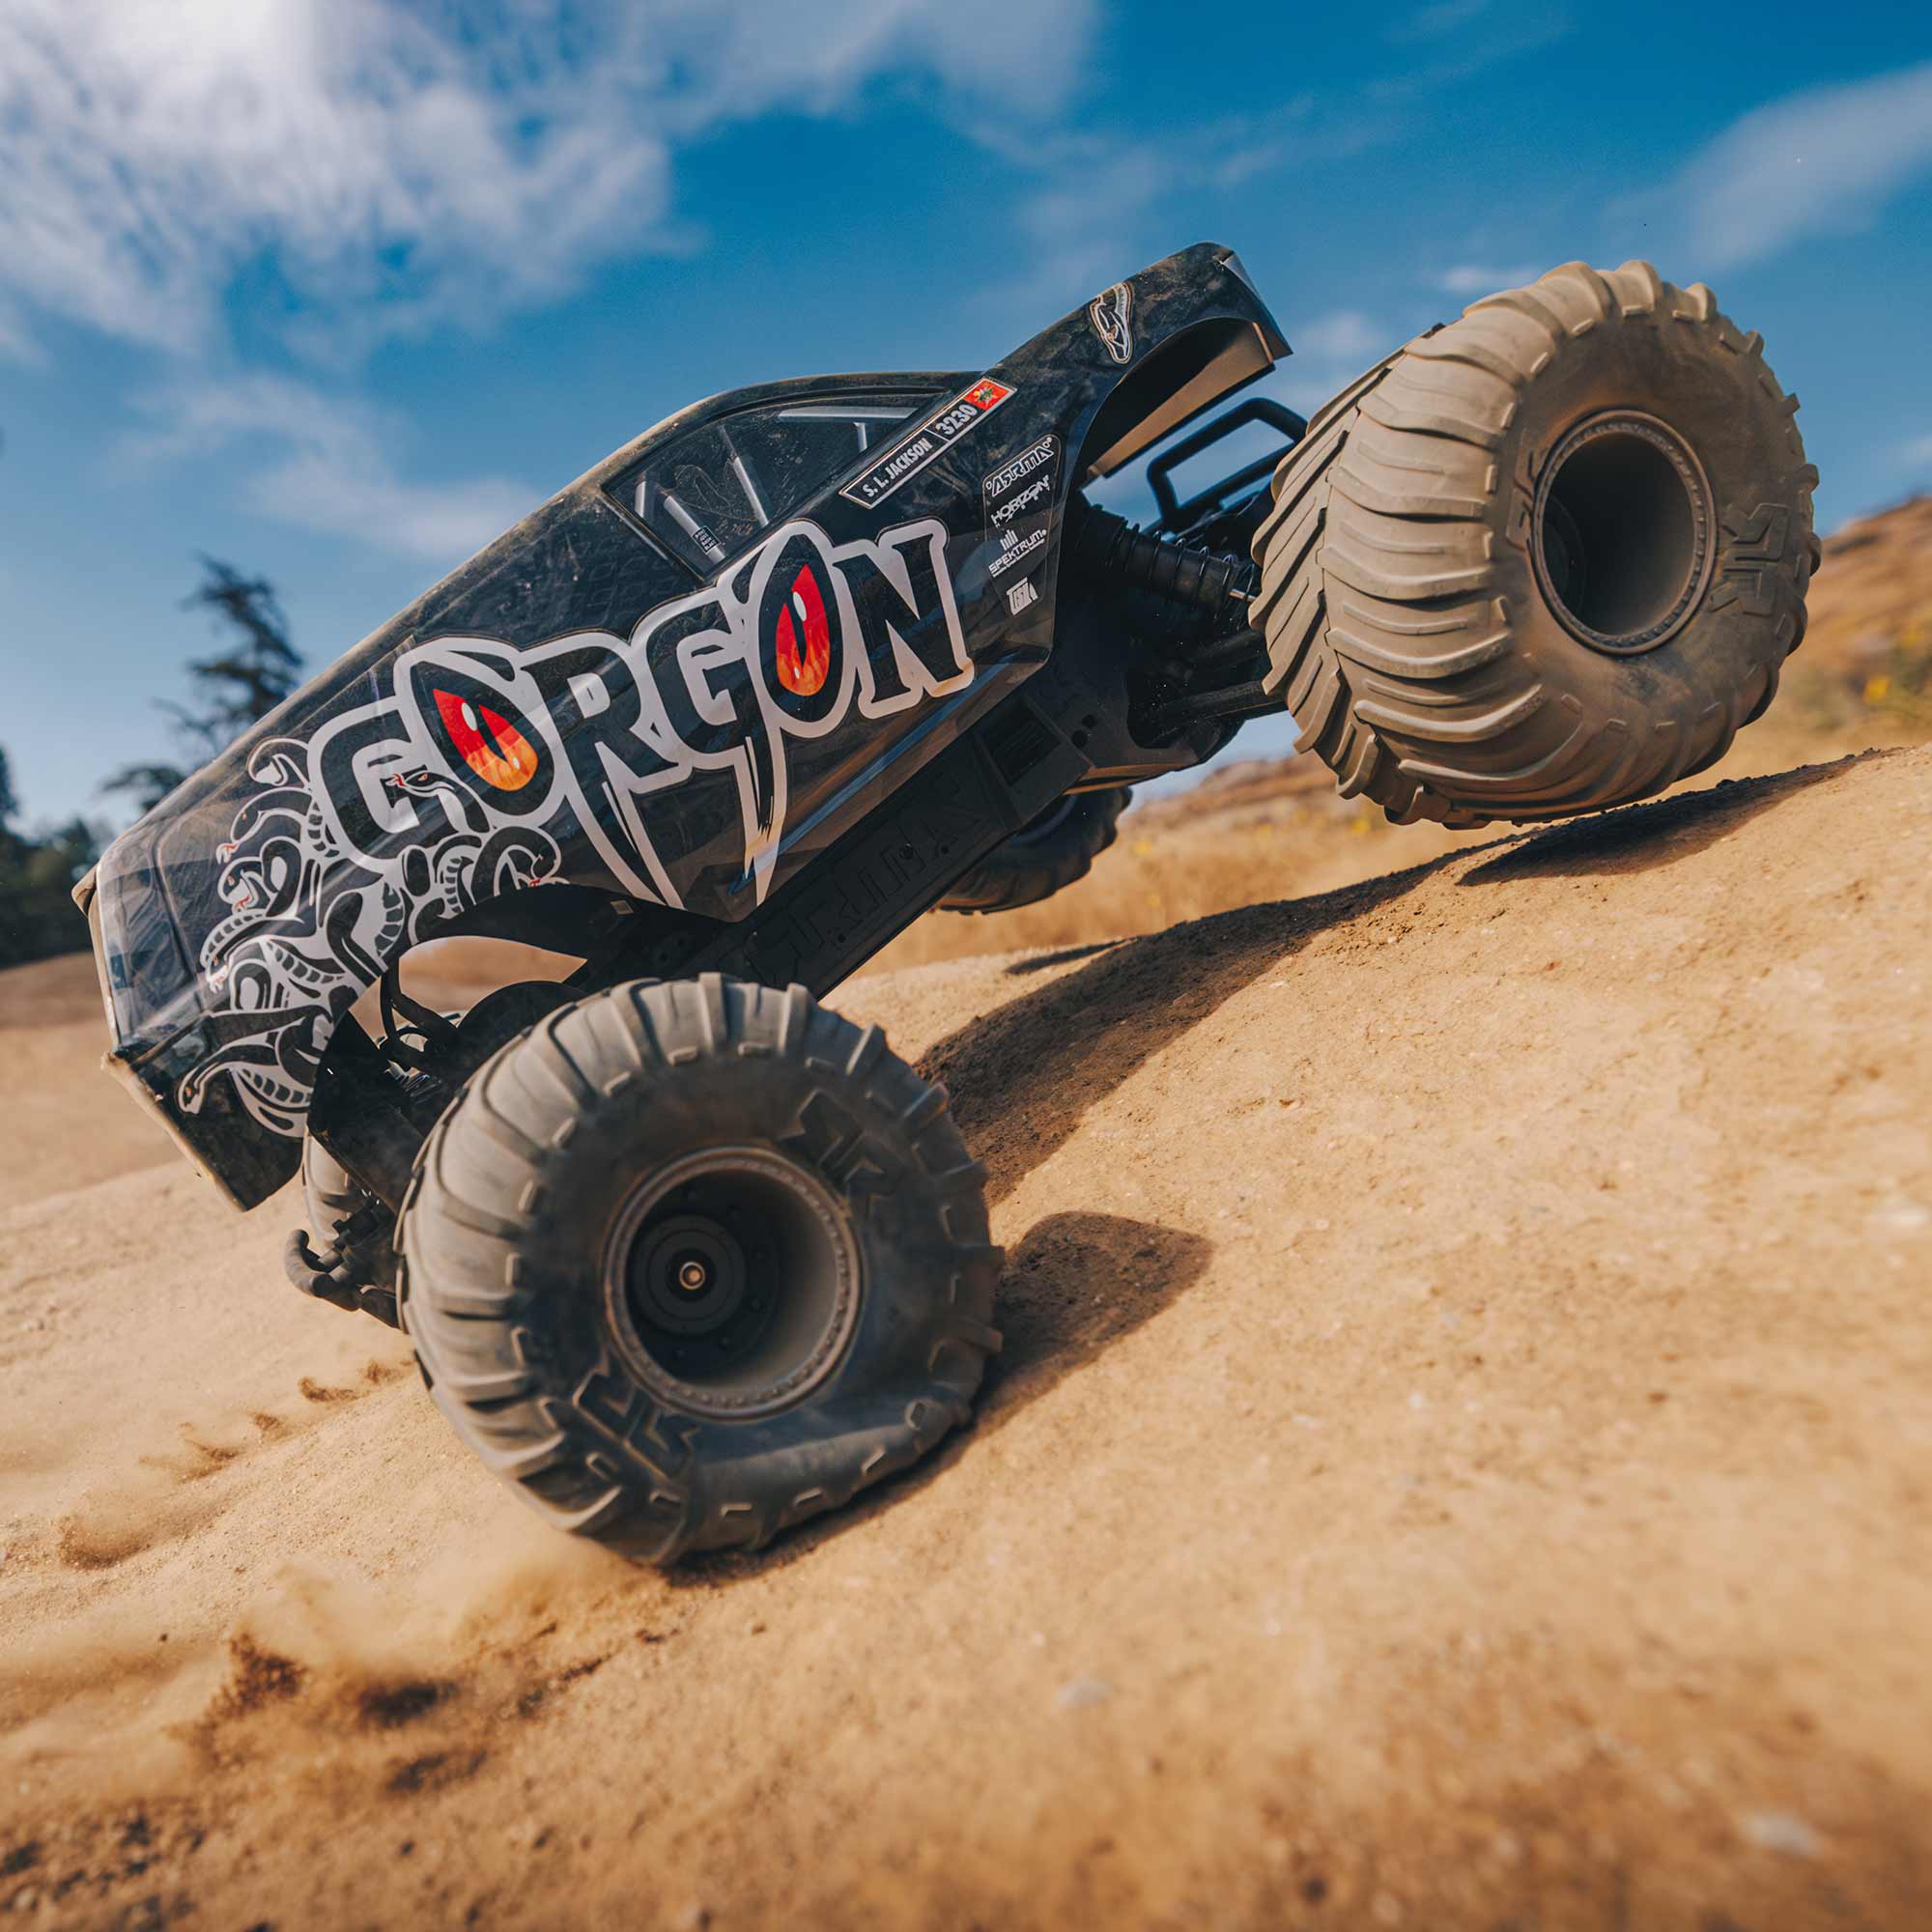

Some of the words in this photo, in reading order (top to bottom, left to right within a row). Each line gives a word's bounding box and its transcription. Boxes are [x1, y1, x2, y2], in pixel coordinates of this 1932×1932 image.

[862, 484, 876, 497] S.
[887, 438, 933, 478] JACKSON
[936, 405, 978, 435] 3230
[990, 476, 1049, 523] HORIZON
[988, 534, 1042, 574] SPEKTRUM
[307, 518, 975, 910] GORGON
